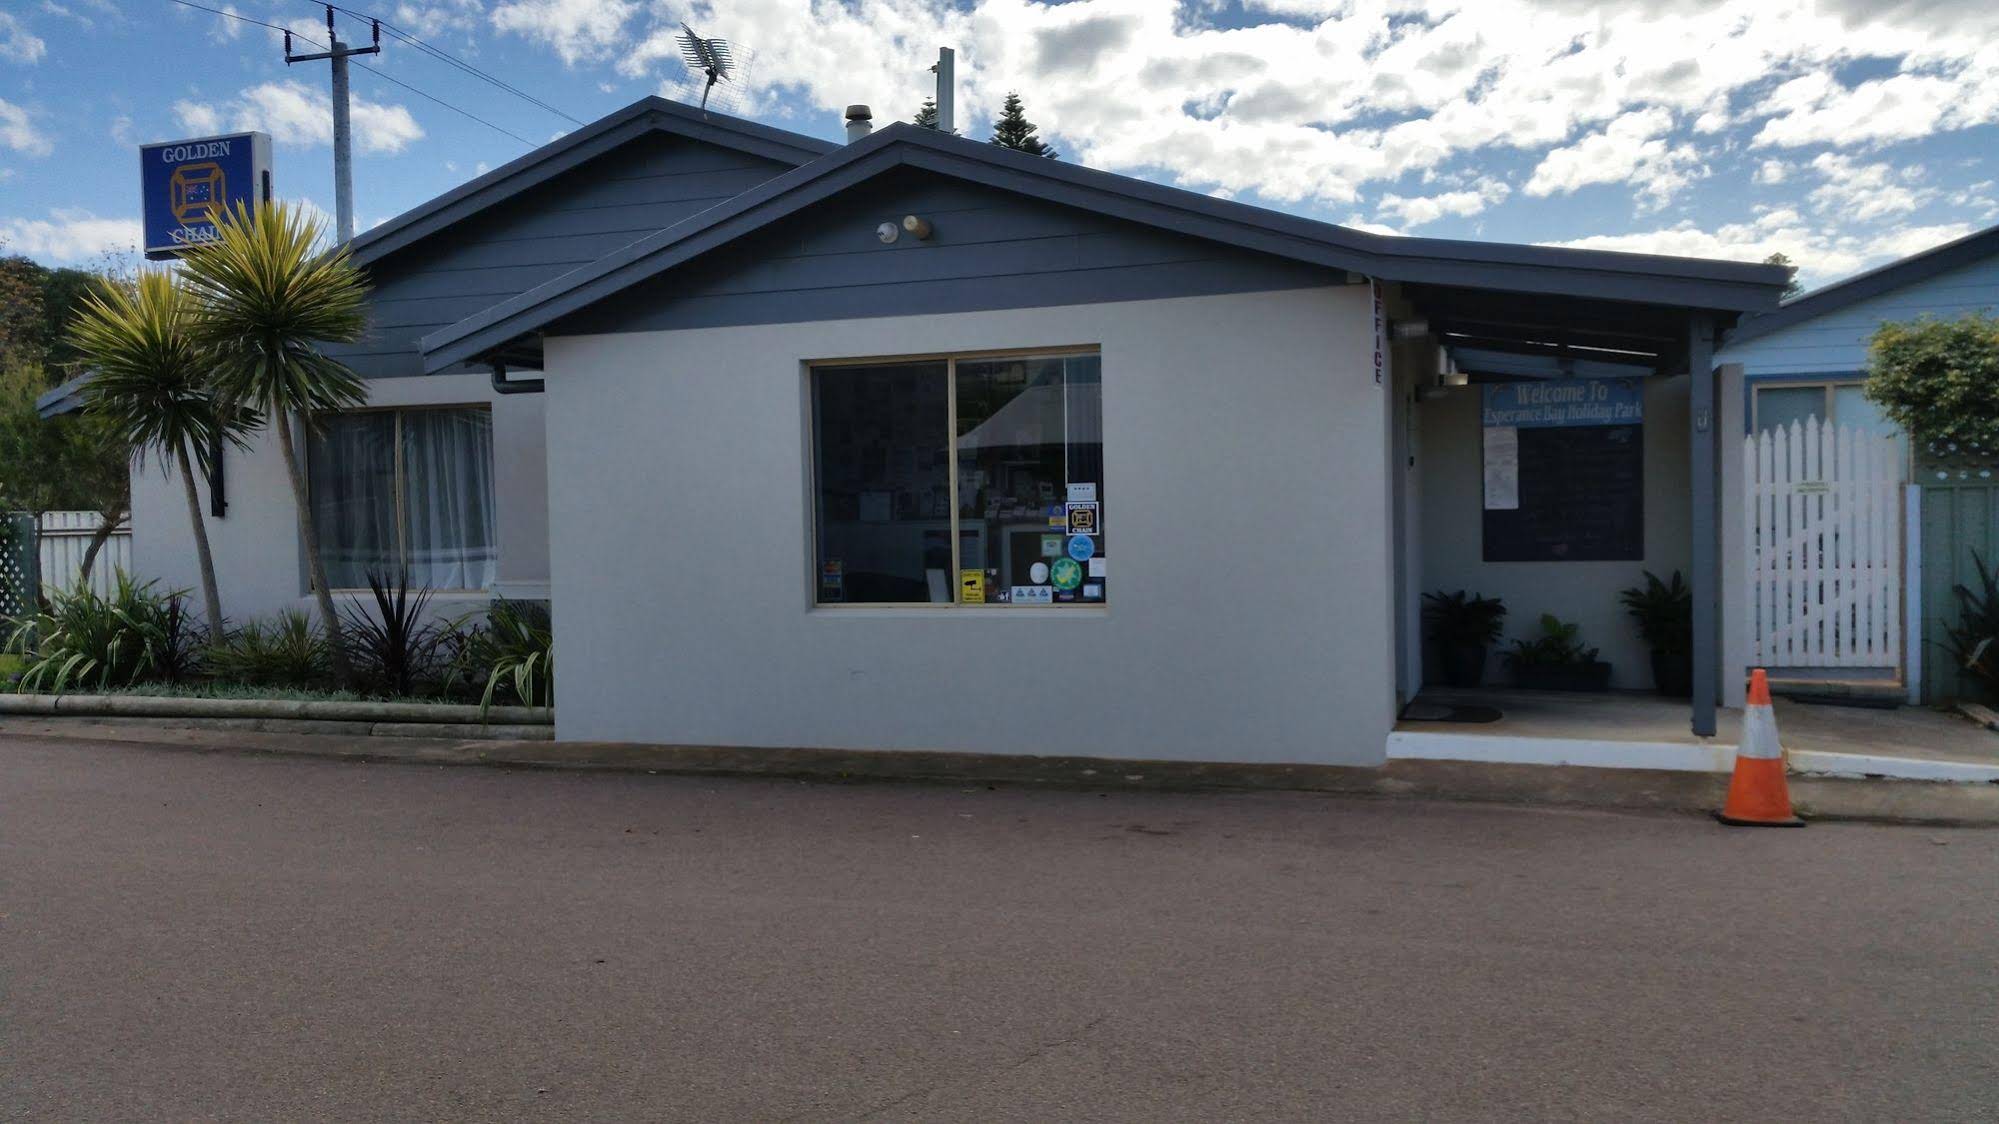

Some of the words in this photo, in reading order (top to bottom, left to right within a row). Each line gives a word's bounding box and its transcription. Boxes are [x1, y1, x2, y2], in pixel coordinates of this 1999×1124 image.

[162, 141, 231, 163] GOLDEN
[1374, 282, 1383, 384] OFFICE
[1517, 381, 1585, 405] Welcome
[1589, 380, 1609, 401] To
[1484, 407, 1541, 426] Esperance
[1543, 405, 1566, 424] Bay
[1567, 402, 1614, 422] Holiday
[1614, 401, 1643, 419] Park
